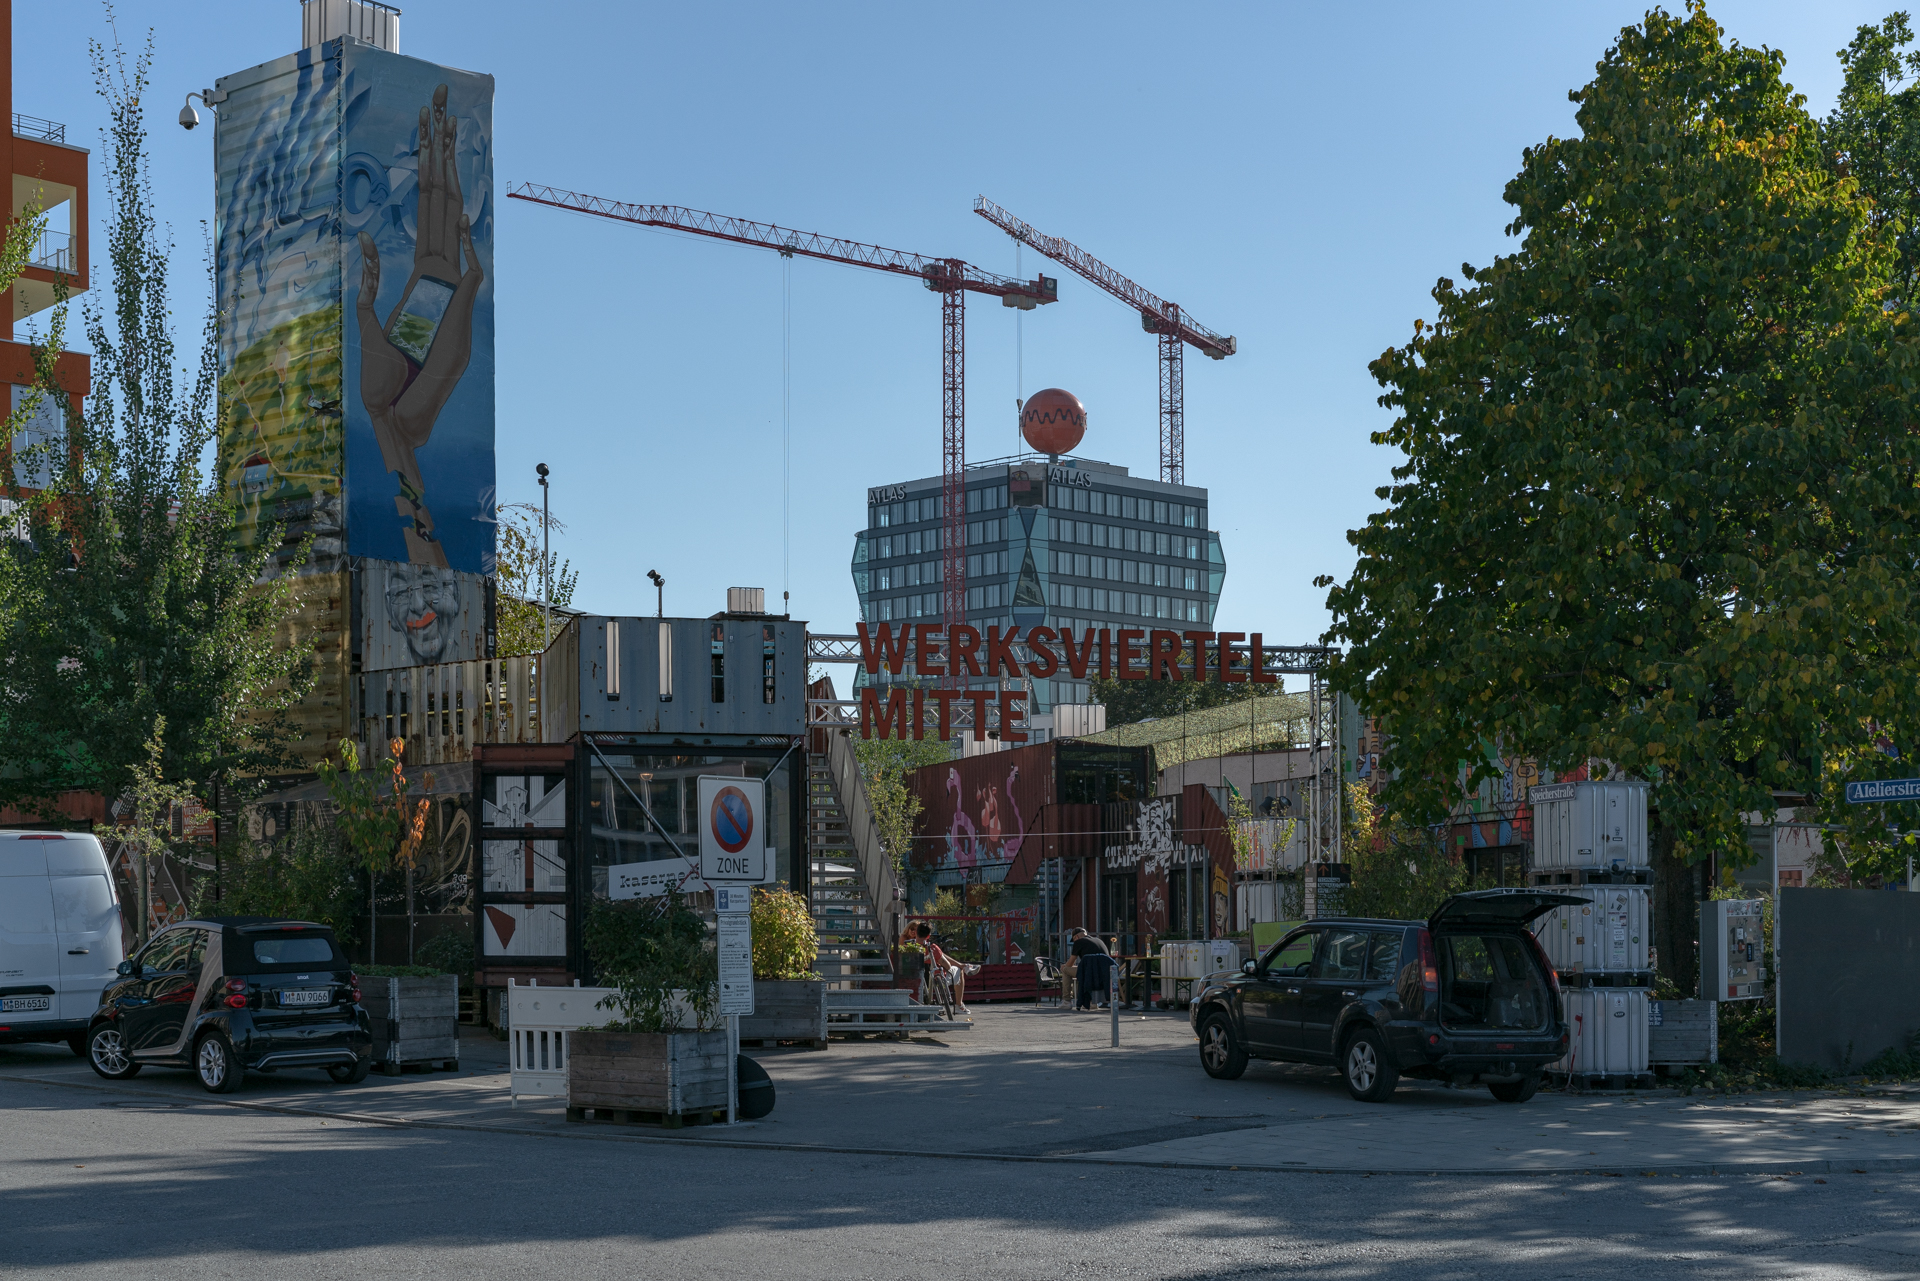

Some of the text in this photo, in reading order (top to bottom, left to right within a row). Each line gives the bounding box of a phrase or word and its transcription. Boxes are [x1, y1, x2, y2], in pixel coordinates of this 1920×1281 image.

[1050, 467, 1092, 487] ATLAS
[867, 485, 906, 504] ATLAS
[856, 621, 1277, 683] WERKSVIERTEL
[861, 687, 1029, 742] MITTE
[1530, 785, 1574, 802] Speicherstraße
[717, 857, 749, 874] ZONE
[620, 872, 686, 888] kaserne
[14, 1000, 26, 1009] BH
[27, 999, 48, 1009] 6516
[296, 992, 307, 1002] AV
[308, 992, 328, 1002] 9066
